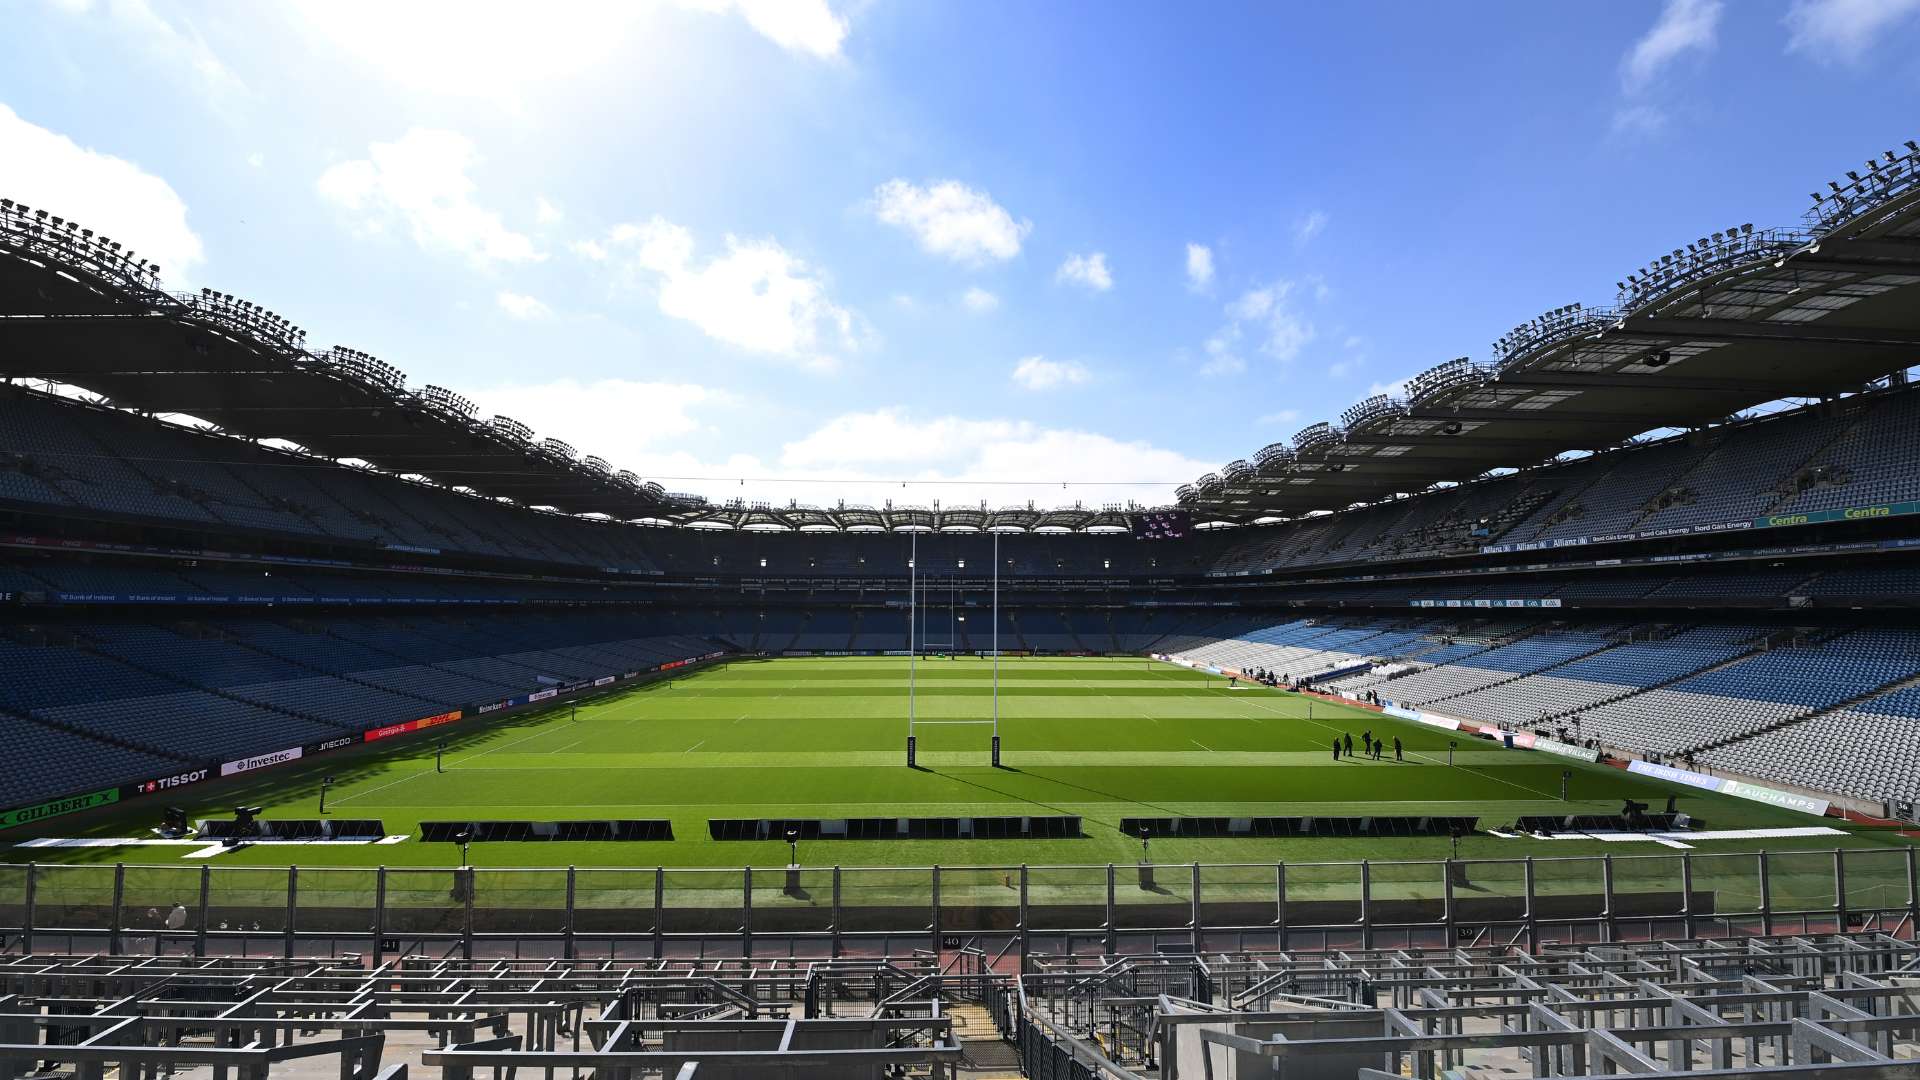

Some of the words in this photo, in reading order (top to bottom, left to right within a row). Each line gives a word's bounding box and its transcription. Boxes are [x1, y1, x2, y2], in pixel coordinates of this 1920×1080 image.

[1845, 506, 1890, 518] Centra
[1727, 521, 1752, 529] Energy
[1769, 515, 1808, 526] Centra
[1669, 527, 1690, 535] Energy
[1617, 533, 1635, 541] Energy
[1516, 543, 1537, 551] Allianz
[1553, 539, 1576, 547] Allianz
[1483, 546, 1502, 554] Allianz
[1567, 749, 1597, 760] VILLAGE
[246, 752, 290, 769] Investec
[158, 769, 208, 789] TISSOT
[16, 797, 93, 823] GILBERT
[1460, 928, 1473, 937] 39
[383, 940, 396, 949] 41
[945, 937, 959, 945] 40
